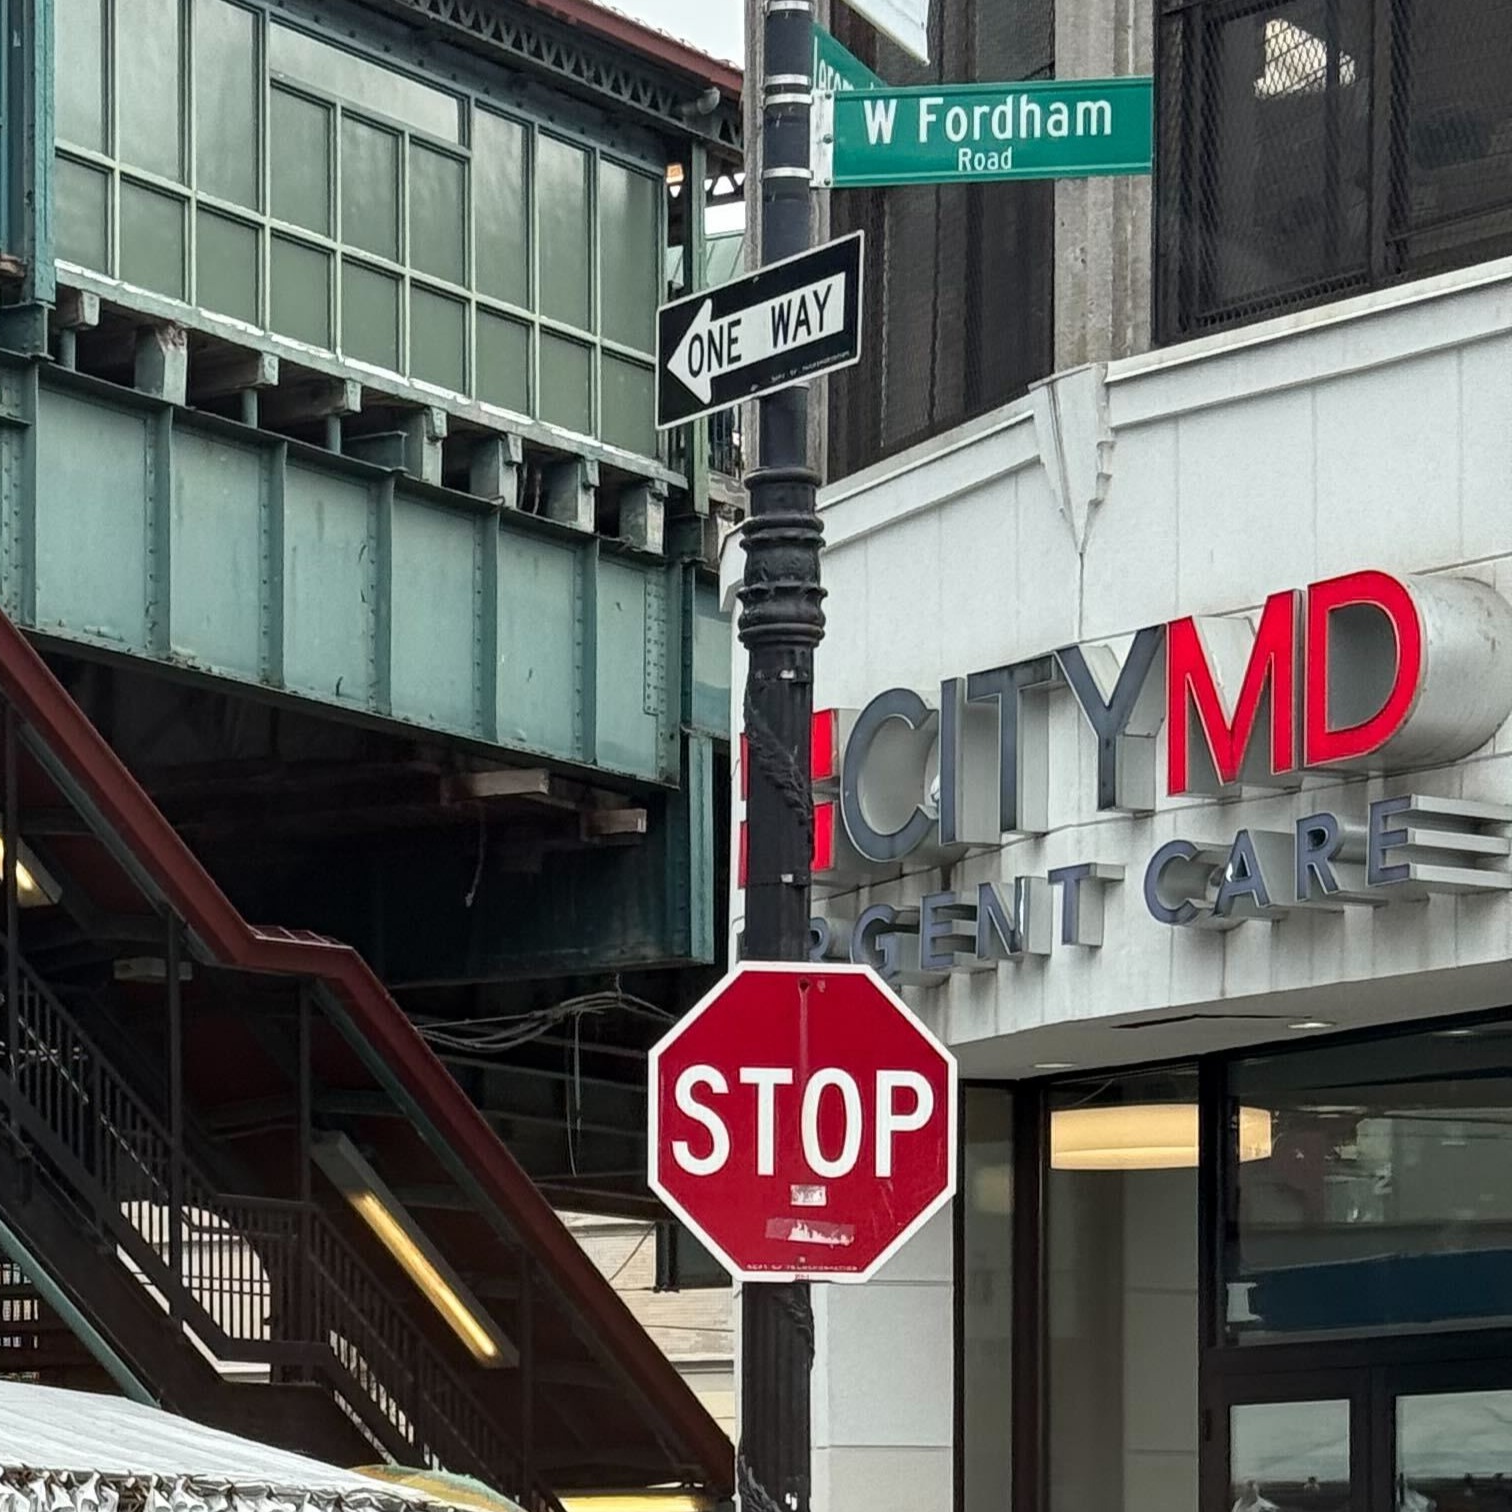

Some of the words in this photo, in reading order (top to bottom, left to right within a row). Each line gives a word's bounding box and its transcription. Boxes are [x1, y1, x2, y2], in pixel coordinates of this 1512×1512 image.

[864, 98, 897, 145] W
[918, 94, 1113, 144] Fordham
[958, 146, 1013, 172] Road
[687, 318, 743, 379] ONE
[770, 283, 834, 350] WAY
[841, 570, 1421, 863] CITYMD
[1144, 799, 1410, 926] CARE
[671, 1063, 935, 1180] STOP
